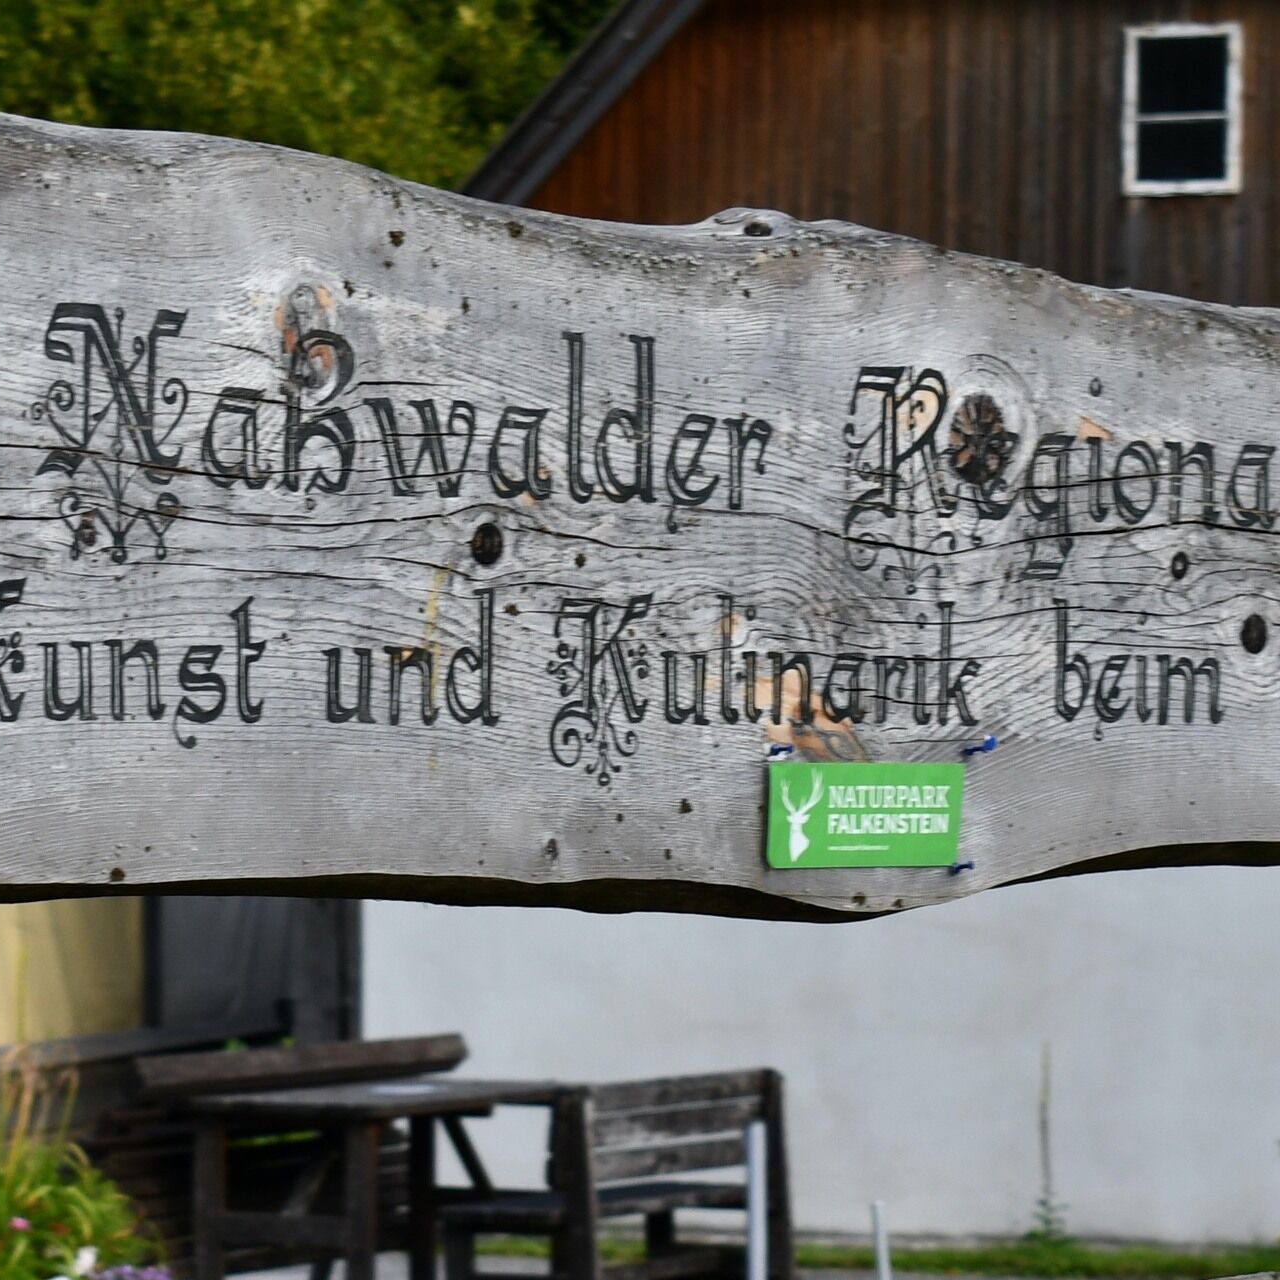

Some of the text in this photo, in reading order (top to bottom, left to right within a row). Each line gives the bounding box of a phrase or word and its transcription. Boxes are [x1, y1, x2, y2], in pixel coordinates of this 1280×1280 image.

[322, 587, 500, 727] und
[547, 592, 983, 792] Kulinarik
[1052, 597, 1225, 742] beim
[827, 785, 952, 809] NATURPARK
[826, 812, 951, 835] FALKENSTEIN
